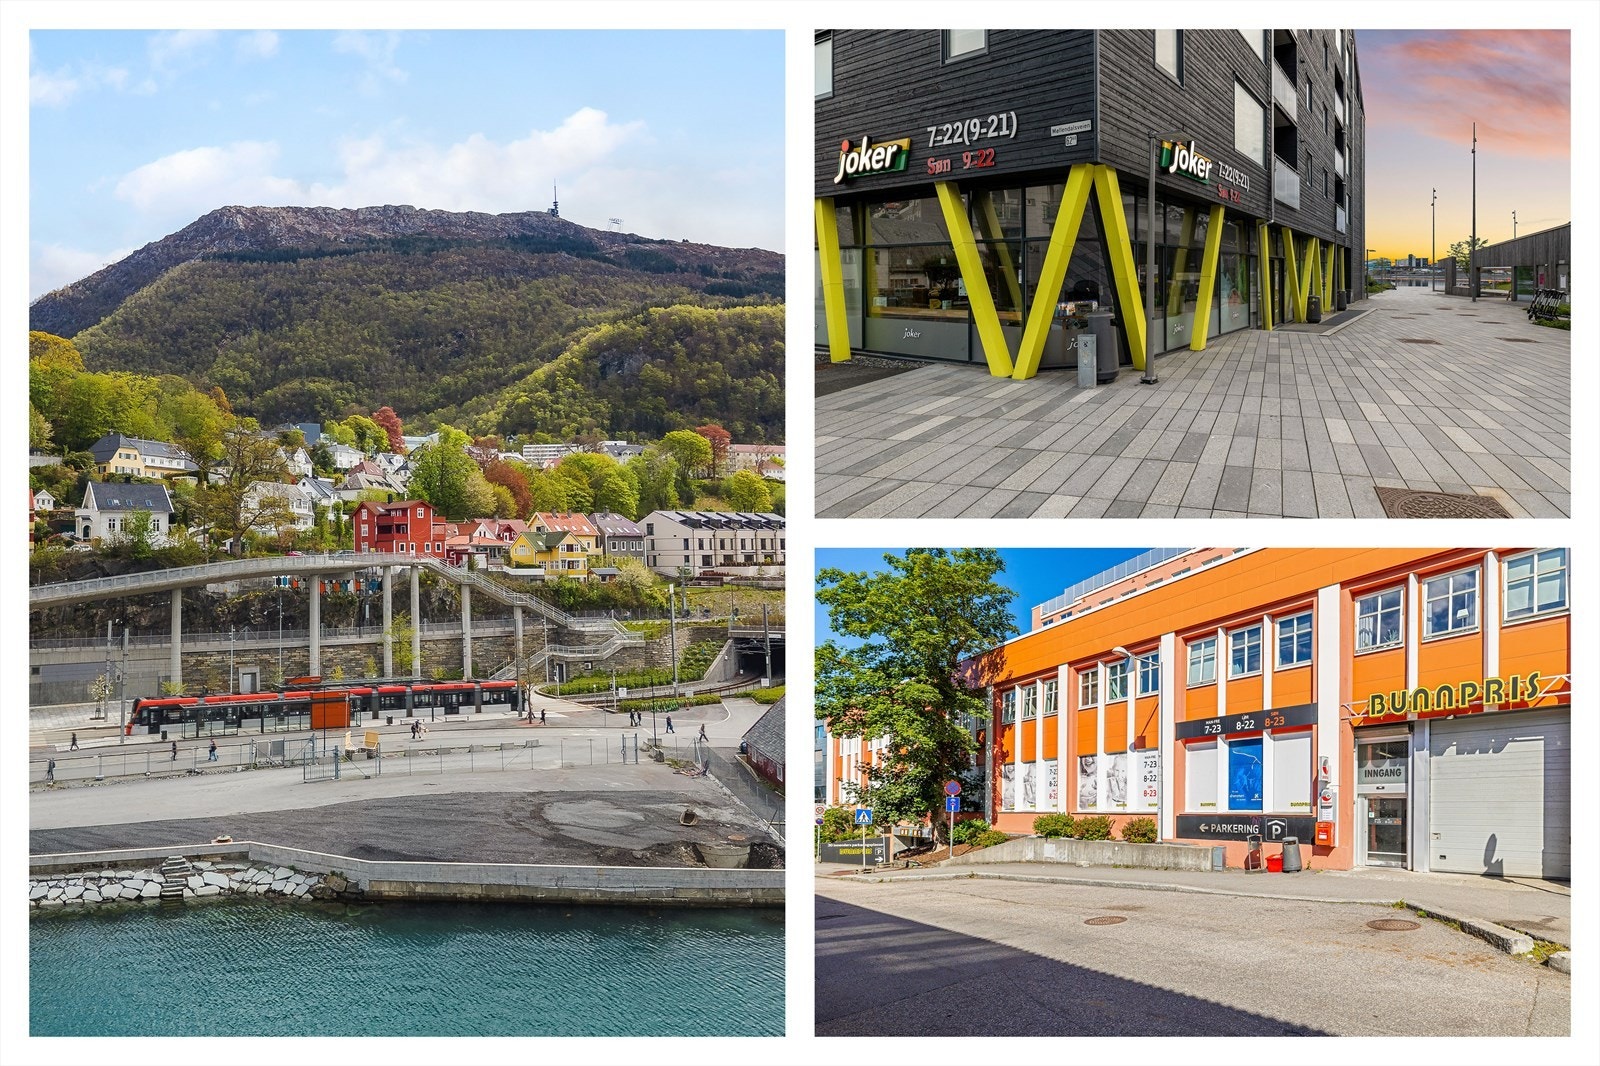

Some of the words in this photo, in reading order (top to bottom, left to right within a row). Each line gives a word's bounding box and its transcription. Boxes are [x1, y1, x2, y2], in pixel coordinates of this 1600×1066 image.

[927, 111, 1017, 147] 7-22(9-21)
[834, 136, 899, 184] joker
[927, 157, 951, 175] Søn
[962, 148, 995, 169] 9-22
[1169, 140, 1212, 179] joker
[903, 328, 921, 339] joker
[1369, 671, 1541, 718] BUNNPRIS
[1236, 720, 1255, 730] 8-22
[1264, 716, 1285, 727] 8-23
[1204, 725, 1222, 734] 7-23
[1364, 768, 1402, 778] INNGANG
[1143, 789, 1157, 797] 8-23
[1210, 822, 1259, 834] PARKERING
[1272, 825, 1282, 839] P
